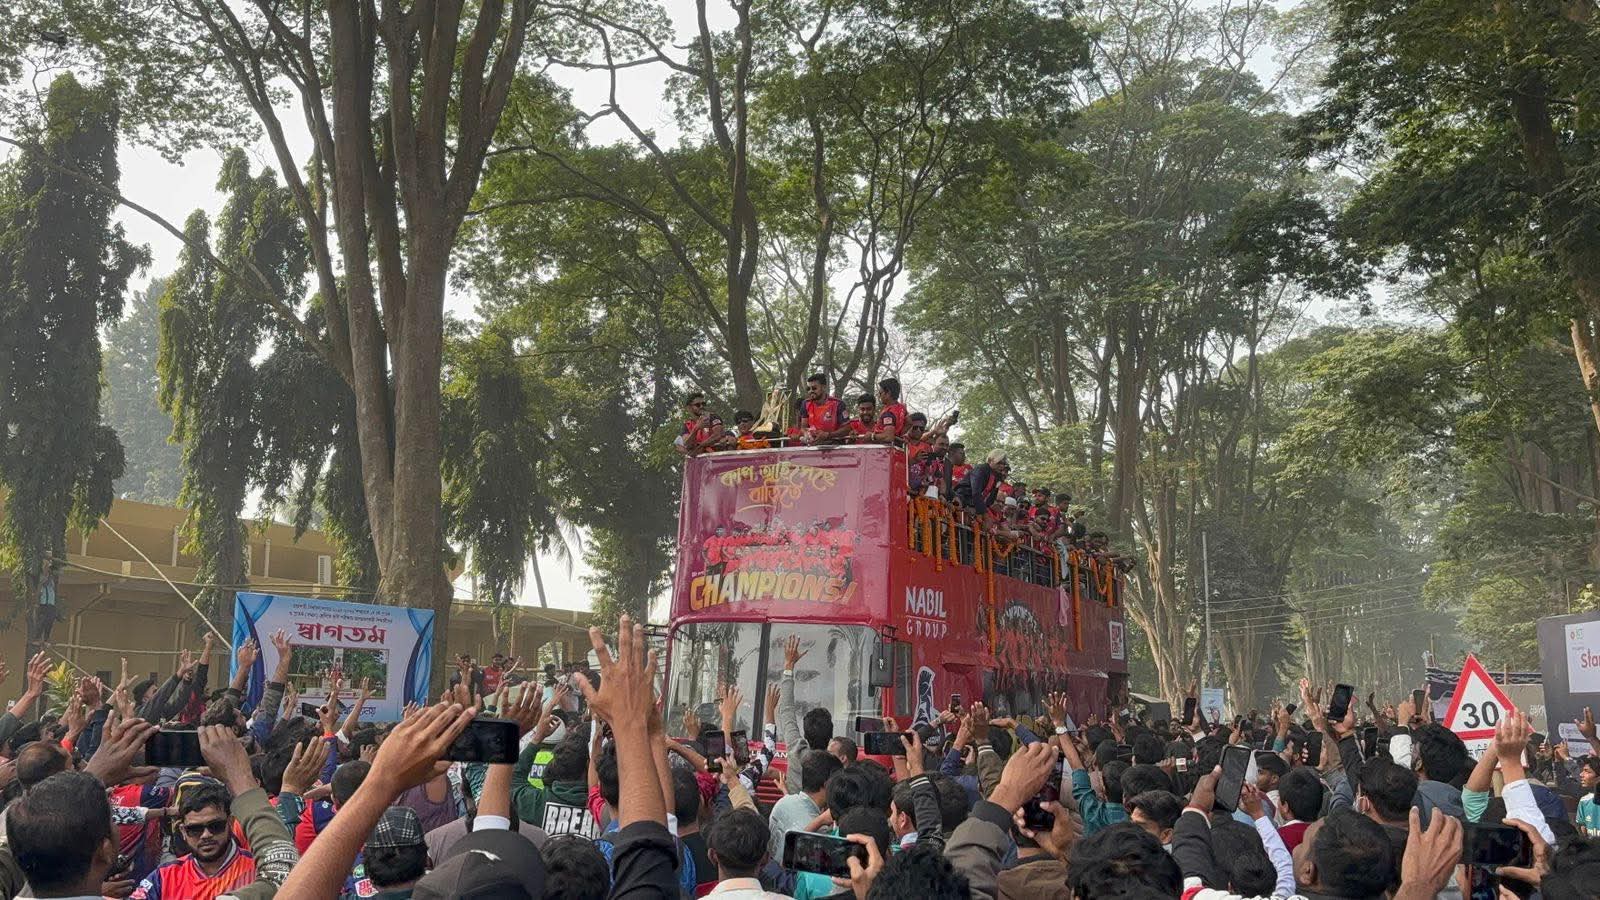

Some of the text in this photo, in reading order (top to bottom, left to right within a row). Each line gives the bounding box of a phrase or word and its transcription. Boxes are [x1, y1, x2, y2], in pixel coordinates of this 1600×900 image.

[719, 464, 757, 487] কাপ
[689, 571, 857, 611] CHAMPIONS!
[905, 586, 947, 618] NABIL
[295, 622, 387, 645] স্বাগতম
[906, 619, 947, 640] GROUP
[1461, 701, 1500, 729] 30
